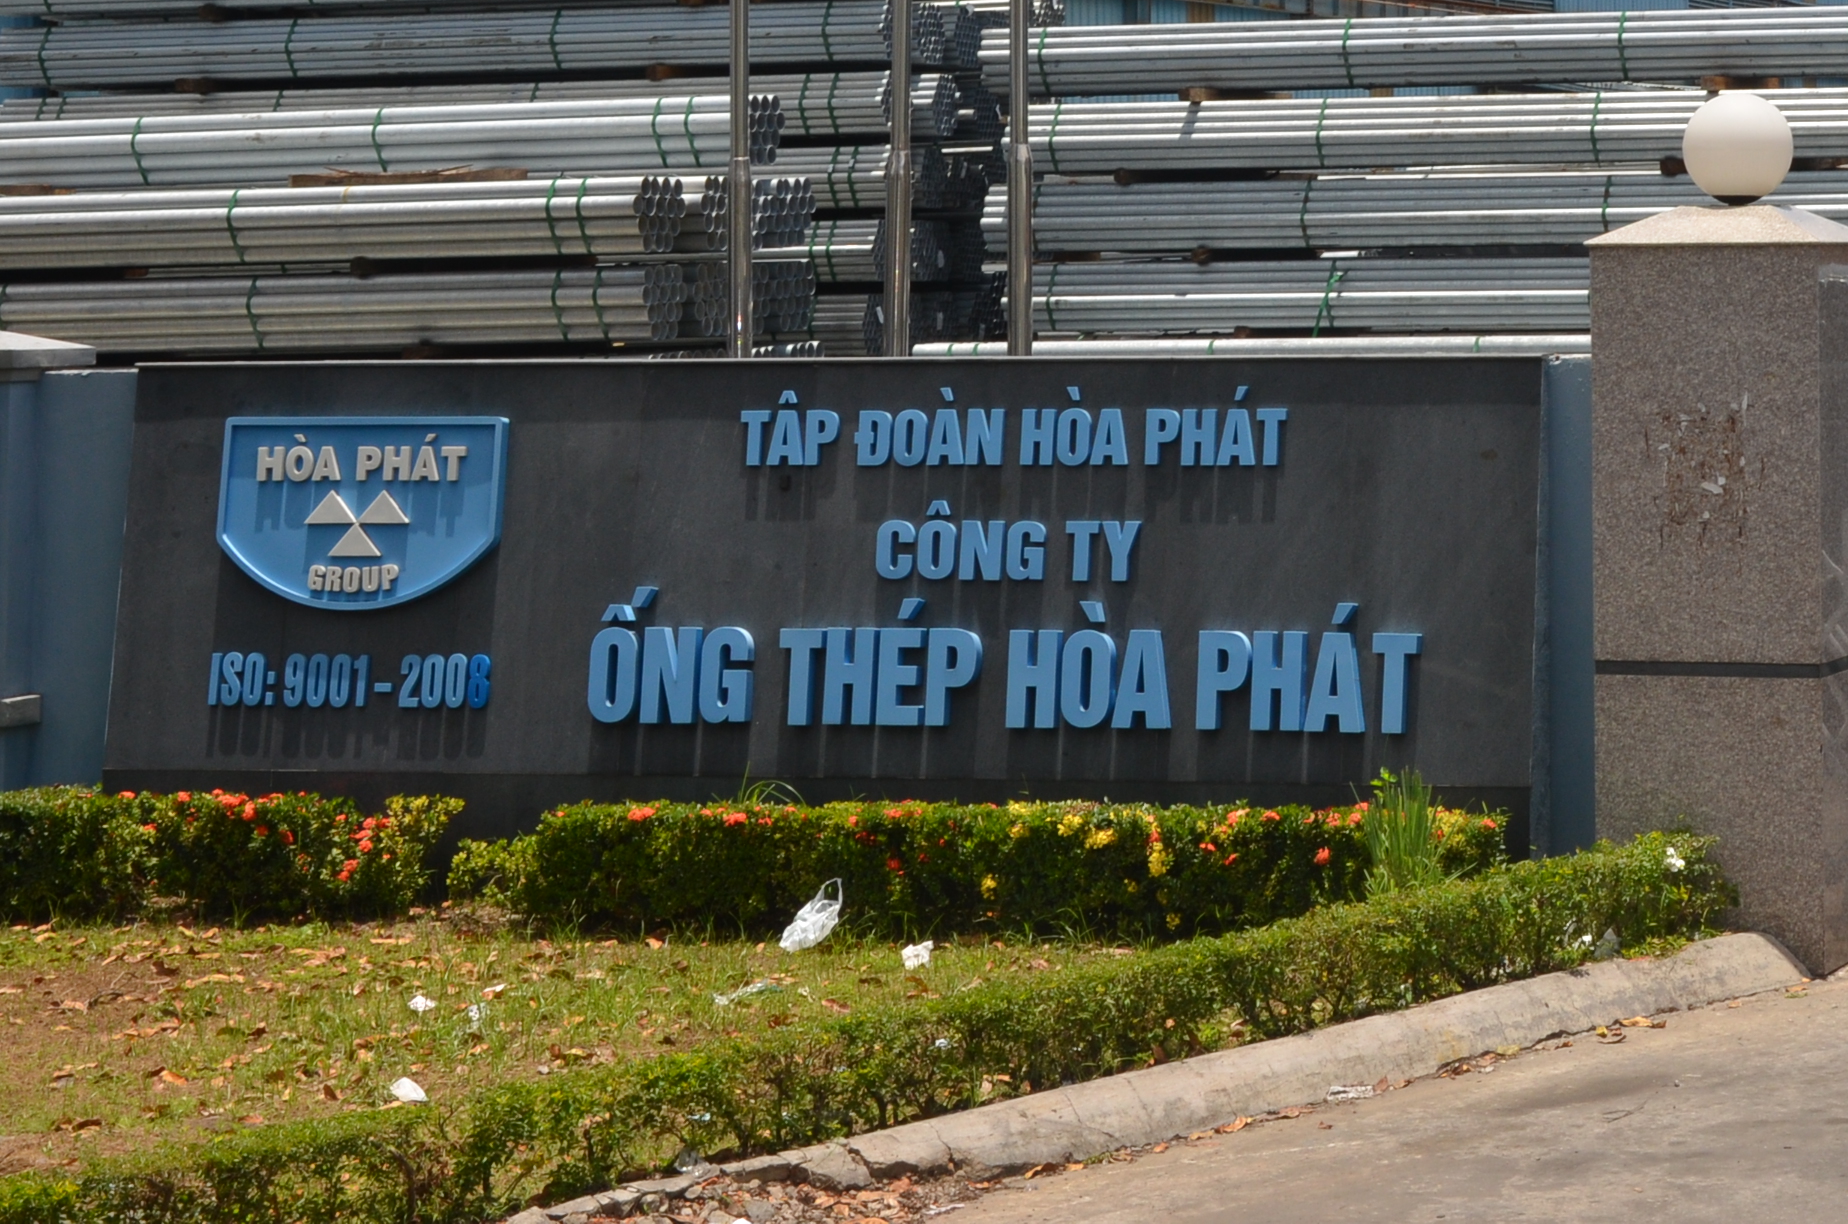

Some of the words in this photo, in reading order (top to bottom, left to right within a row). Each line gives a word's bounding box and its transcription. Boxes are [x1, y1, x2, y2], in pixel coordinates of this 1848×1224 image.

[256, 433, 341, 482] HÒA
[355, 433, 468, 482] PHÁT
[854, 387, 1003, 467] ĐOÀN
[1020, 386, 1129, 466] HÒA
[1144, 385, 1288, 466] PHÁT
[306, 564, 399, 593] GROUP
[875, 500, 1047, 582] CÔNG
[1065, 520, 1142, 582] TY
[587, 586, 756, 725] ỐNG
[779, 598, 982, 726] THÉP
[1005, 601, 1172, 730] HÒA
[1195, 602, 1423, 734] PHÁT
